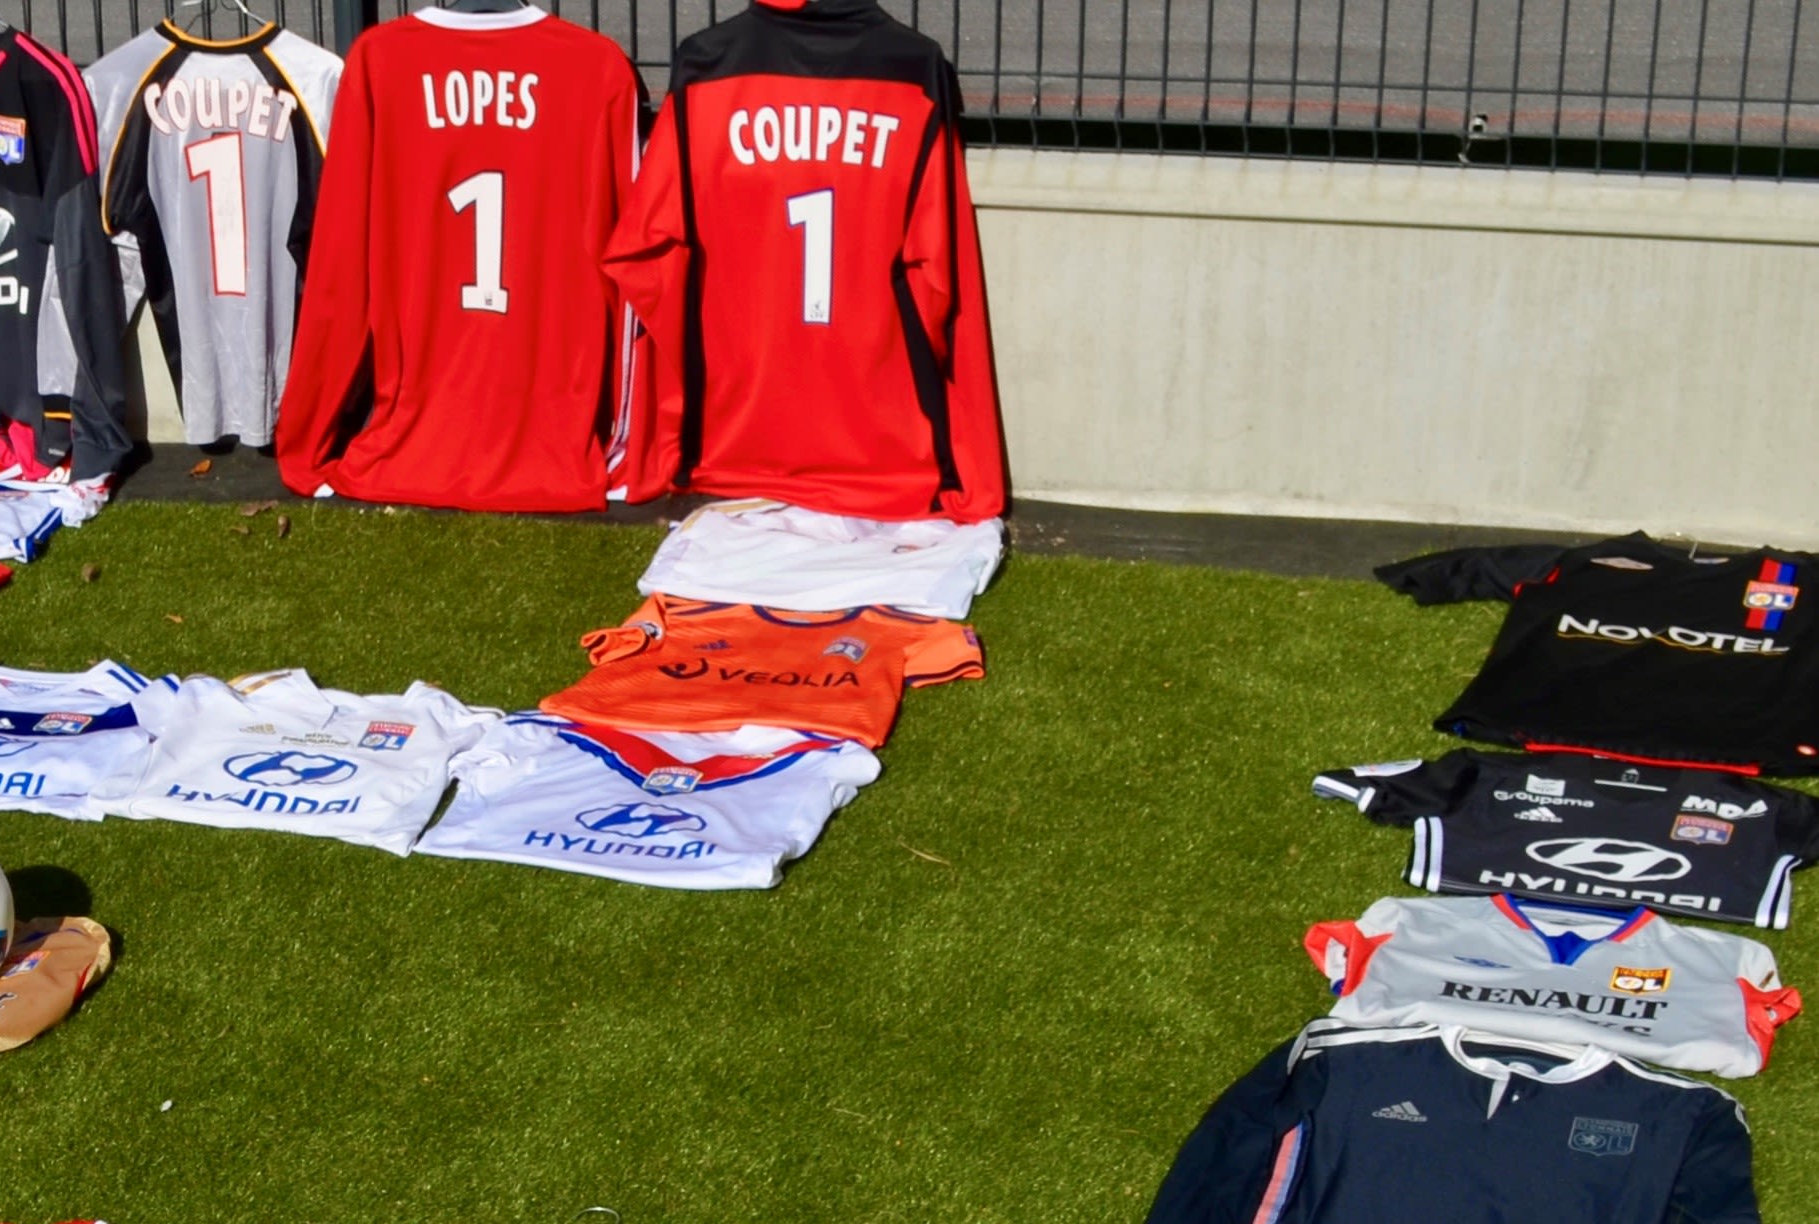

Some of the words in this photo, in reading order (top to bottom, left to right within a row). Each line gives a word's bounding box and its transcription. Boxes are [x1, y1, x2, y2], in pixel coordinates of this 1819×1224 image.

[145, 78, 298, 141] COUPET
[422, 70, 539, 130] LOPES
[729, 105, 899, 169] COUPET
[185, 131, 246, 297] 1
[448, 171, 509, 314] 1
[787, 187, 834, 325] 1
[1748, 592, 1790, 608] OL
[1557, 614, 1790, 653] NOVOTEL
[719, 667, 860, 687] VEOLIA
[1494, 790, 1594, 808] Groupama
[524, 830, 718, 859] HYUNDAI
[1439, 981, 1668, 1020] RENAULT
[1615, 976, 1662, 991] OL
